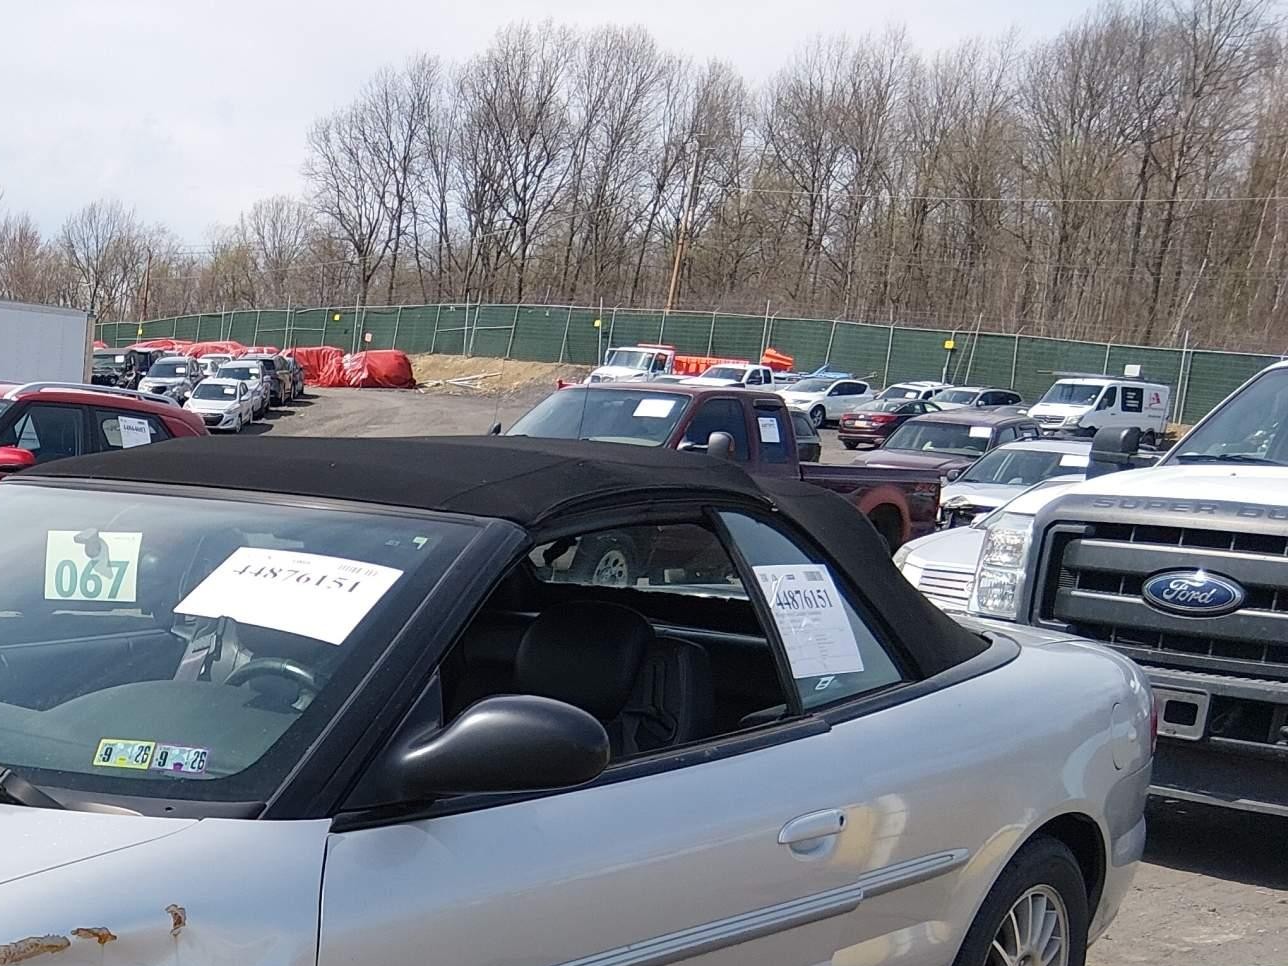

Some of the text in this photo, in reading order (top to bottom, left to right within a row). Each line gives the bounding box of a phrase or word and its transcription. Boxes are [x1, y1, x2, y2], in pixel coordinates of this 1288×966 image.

[1092, 497, 1288, 520] SUPER DU
[55, 560, 130, 599] 067
[233, 564, 361, 593] 44876151
[776, 589, 833, 610] 44876151
[1162, 579, 1217, 604] Ford
[134, 745, 151, 764] 26
[190, 751, 207, 770] 26
